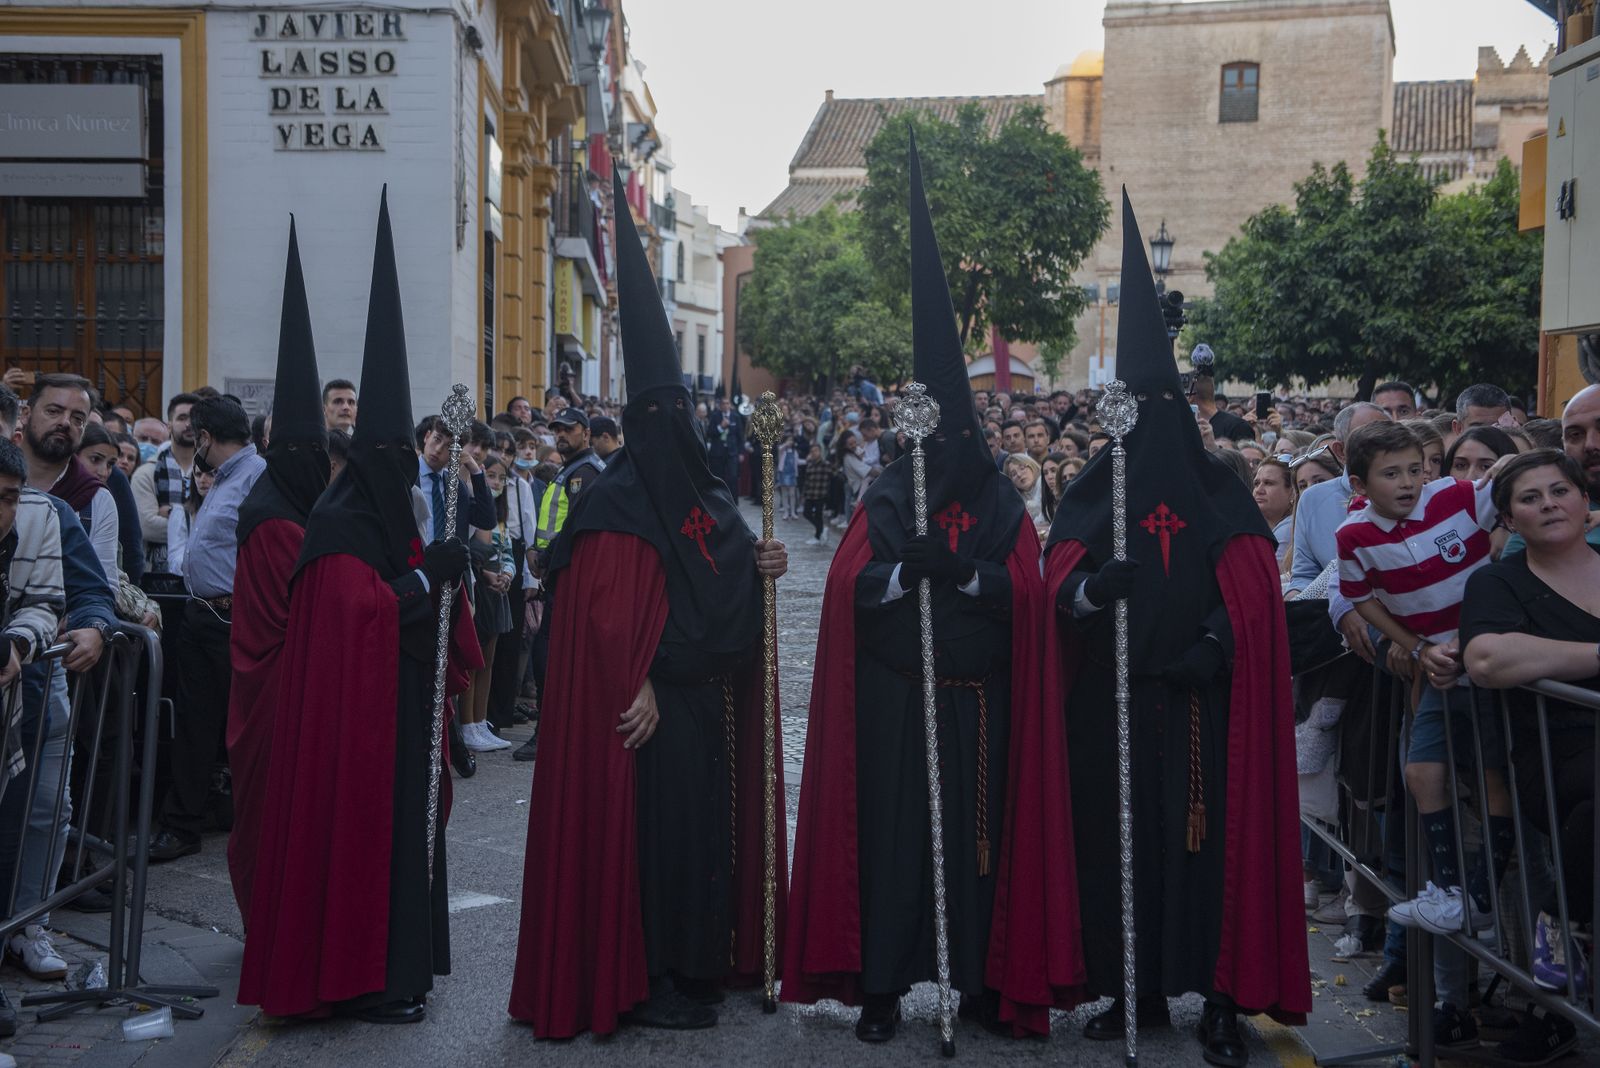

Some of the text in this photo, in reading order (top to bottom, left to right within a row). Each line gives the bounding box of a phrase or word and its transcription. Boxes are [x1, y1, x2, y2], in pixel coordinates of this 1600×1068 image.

[254, 13, 403, 38] JAVIER
[262, 50, 396, 75] LASSO
[271, 87, 384, 110] DE LA
[277, 123, 380, 147] VEGA
